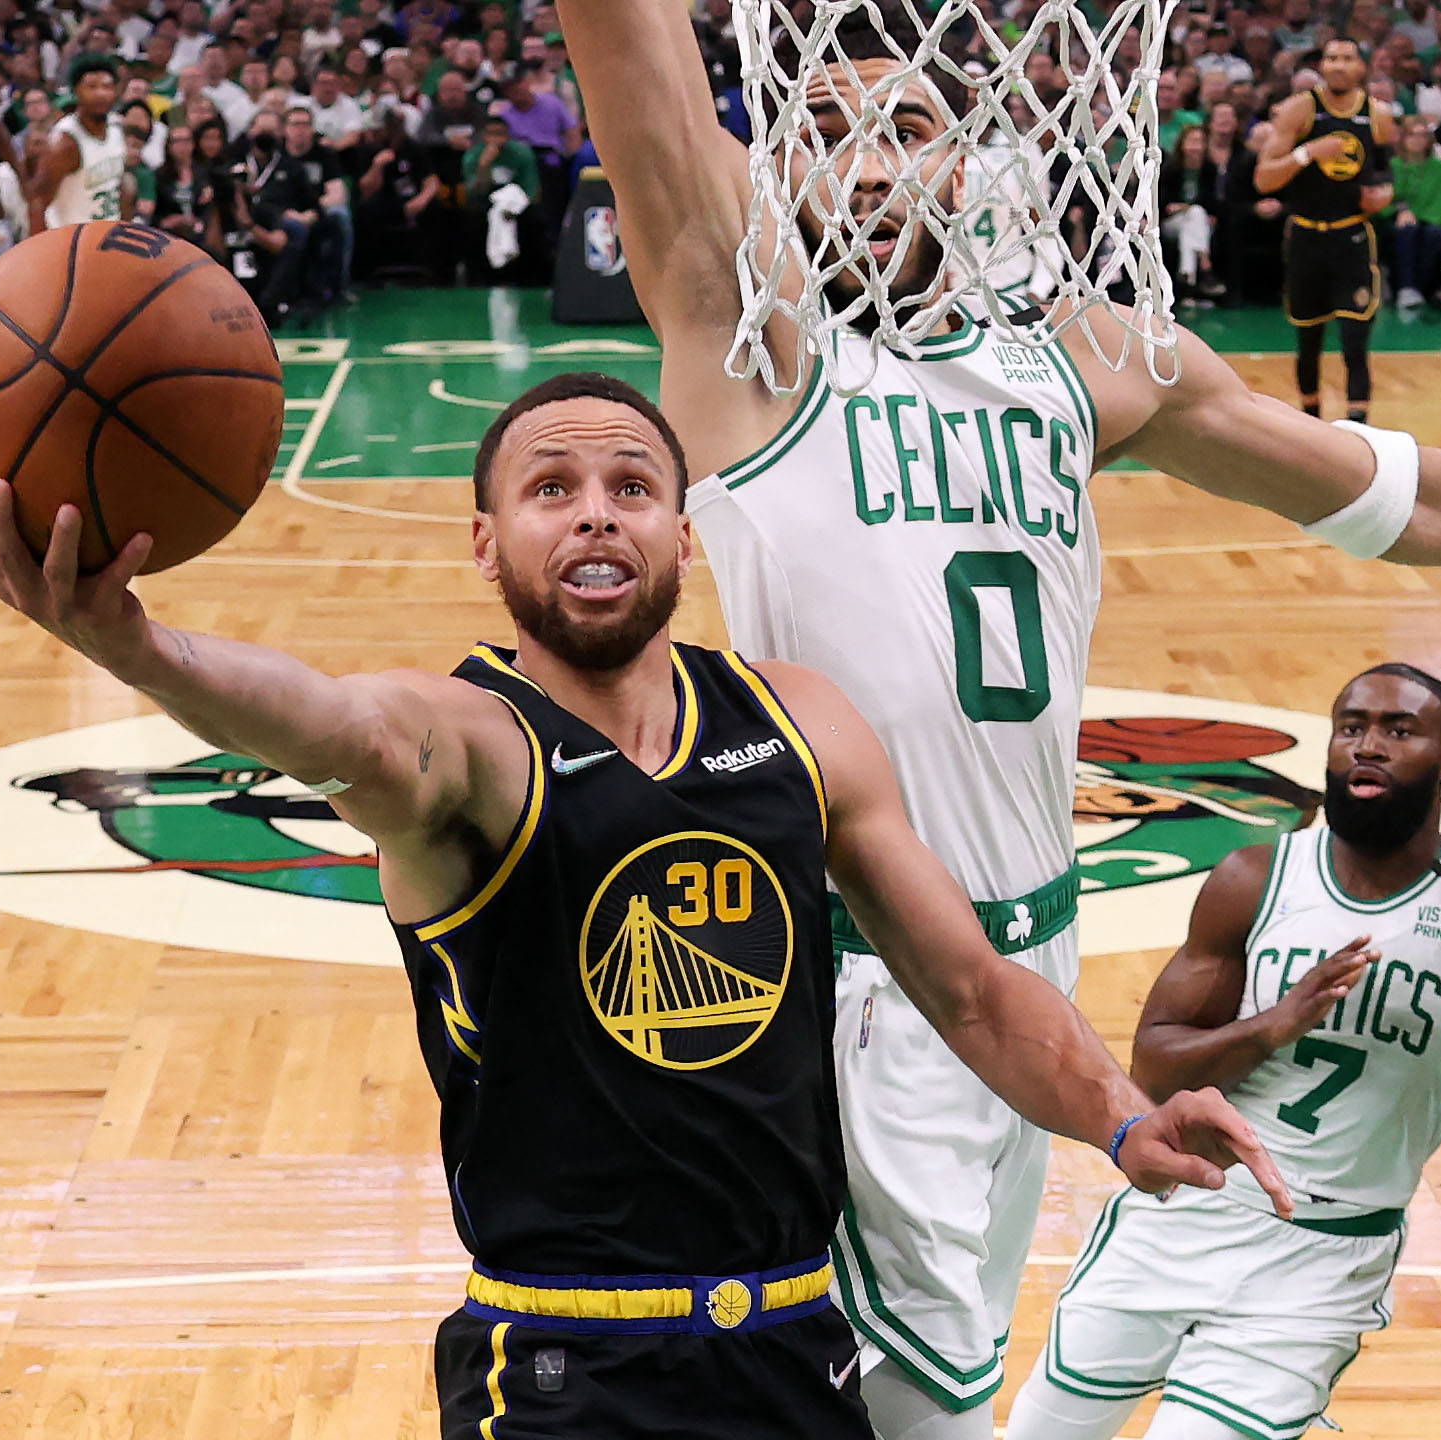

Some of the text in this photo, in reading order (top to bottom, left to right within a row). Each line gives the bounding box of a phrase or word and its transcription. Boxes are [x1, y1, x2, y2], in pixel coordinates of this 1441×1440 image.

[992, 346, 1047, 367] VISTA
[1003, 368, 1054, 384] PRINT
[844, 394, 1081, 550] CELTICS
[944, 551, 1052, 722] 0
[700, 737, 786, 773] Rakuten
[666, 858, 753, 927] 30
[1277, 1036, 1368, 1135] 7
